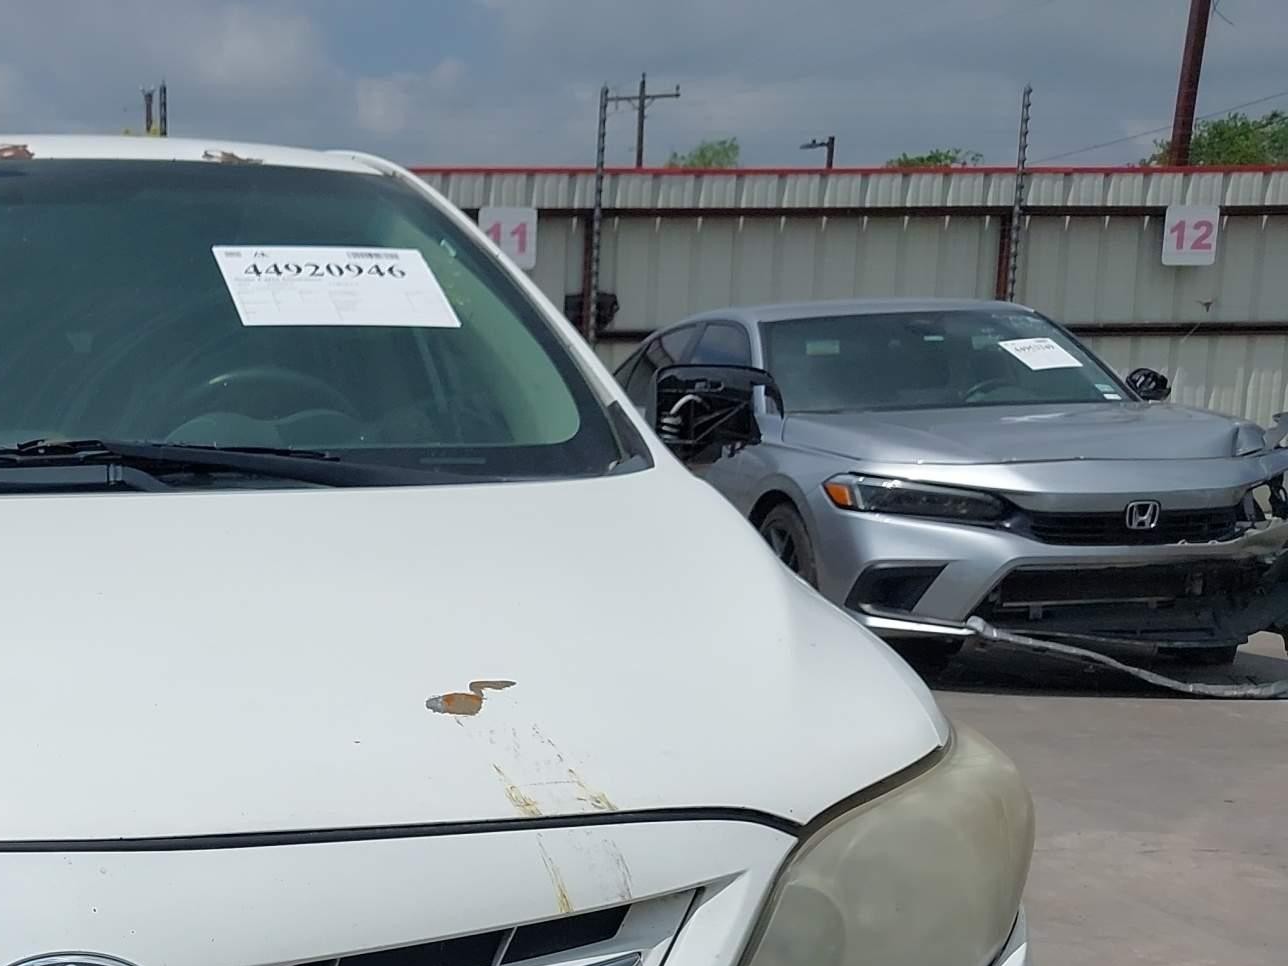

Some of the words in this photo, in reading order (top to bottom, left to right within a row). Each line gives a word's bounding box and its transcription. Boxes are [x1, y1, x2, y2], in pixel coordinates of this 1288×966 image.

[486, 222, 528, 253] 11
[1169, 220, 1214, 250] 12
[243, 261, 407, 279] 44920946
